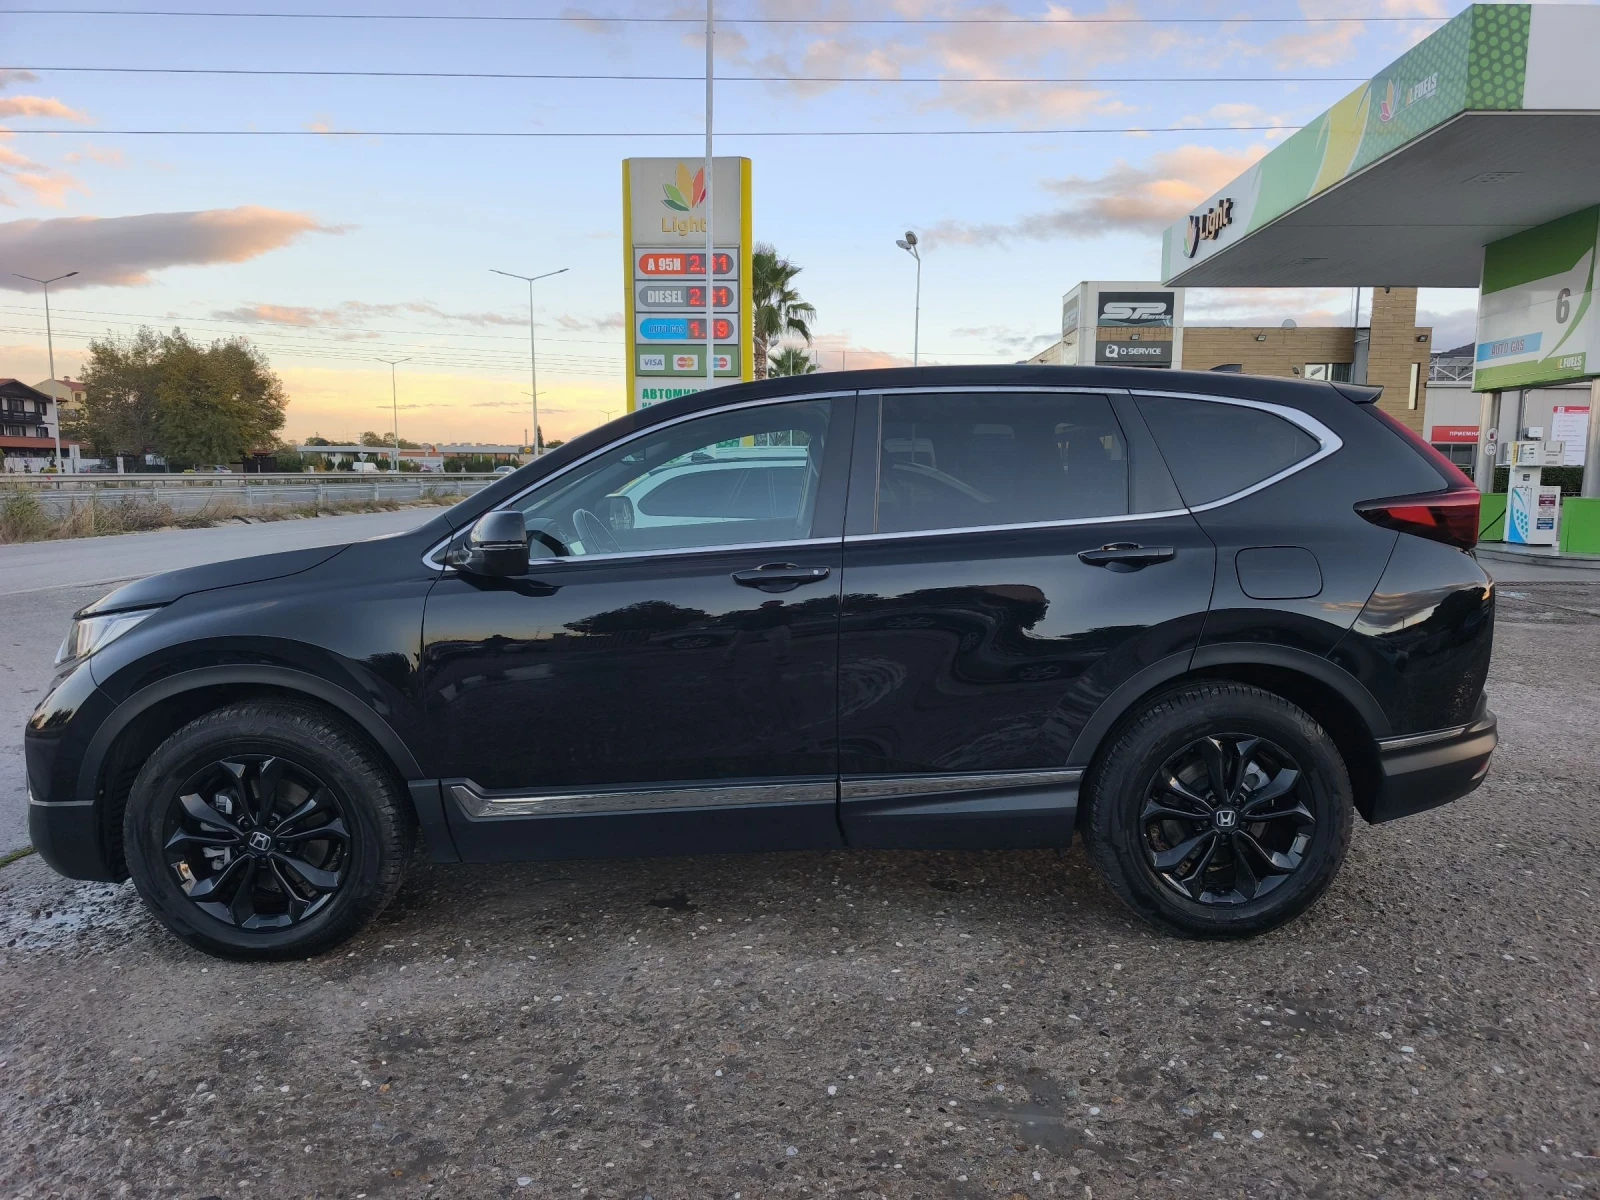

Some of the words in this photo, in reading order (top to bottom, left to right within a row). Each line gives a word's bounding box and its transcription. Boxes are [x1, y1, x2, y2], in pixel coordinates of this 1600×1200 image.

[661, 216, 707, 236] Light
[1200, 197, 1234, 241] Light
[647, 290, 683, 303] DIESEL
[1100, 302, 1167, 320] SP
[1555, 287, 1571, 324] 6
[649, 325, 668, 333] AUTO
[670, 325, 685, 333] GAS
[1491, 342, 1509, 356] AUTO
[1510, 339, 1525, 353] GAS
[643, 358, 663, 366] VISA
